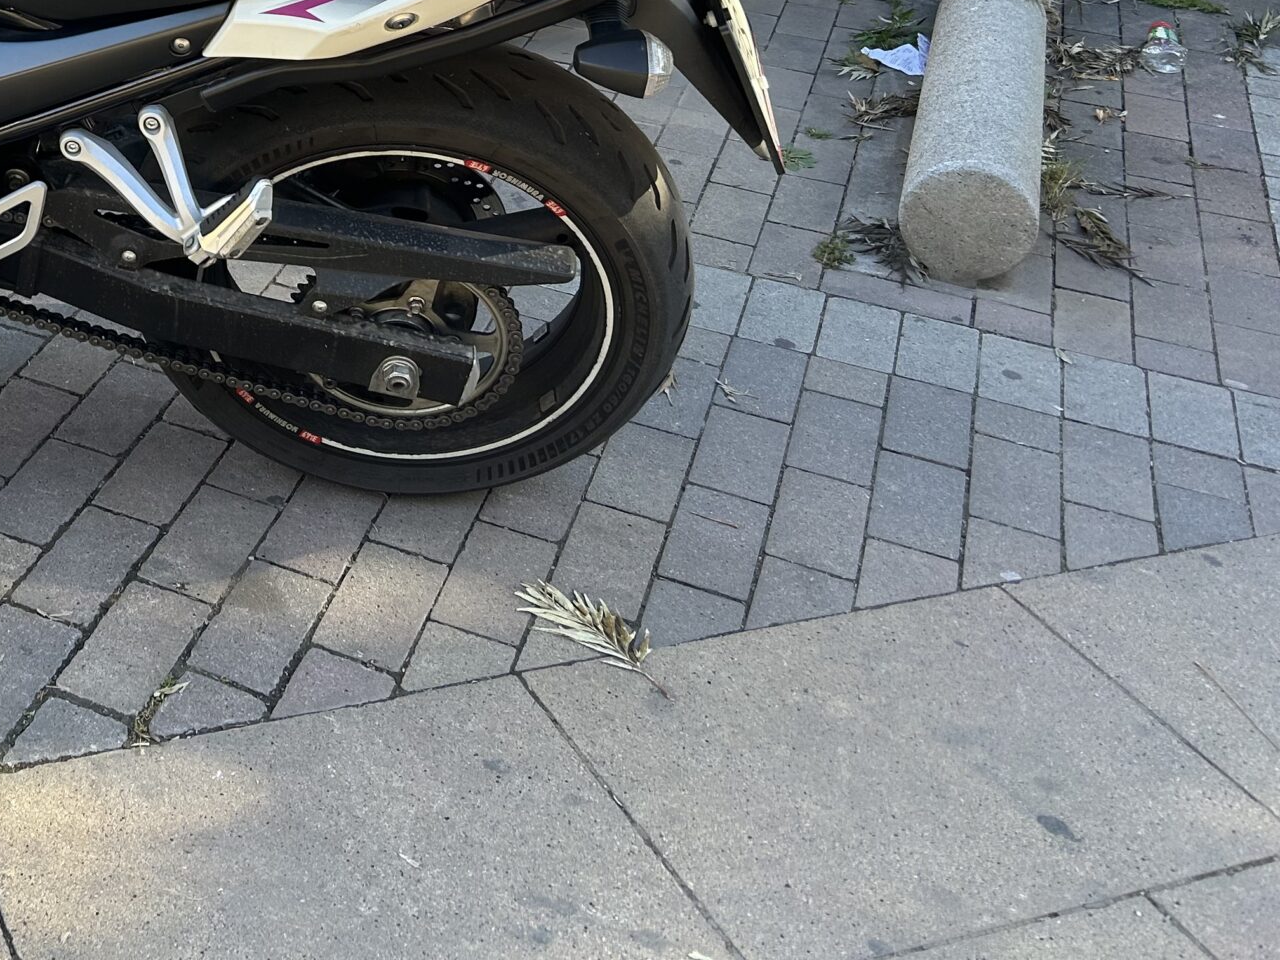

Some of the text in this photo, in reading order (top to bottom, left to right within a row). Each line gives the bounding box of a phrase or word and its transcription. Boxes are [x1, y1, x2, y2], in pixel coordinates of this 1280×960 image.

[491, 170, 545, 201] YOSHIMURA
[630, 267, 650, 359] MICHELIN
[254, 402, 299, 433] YOSHIMURA
